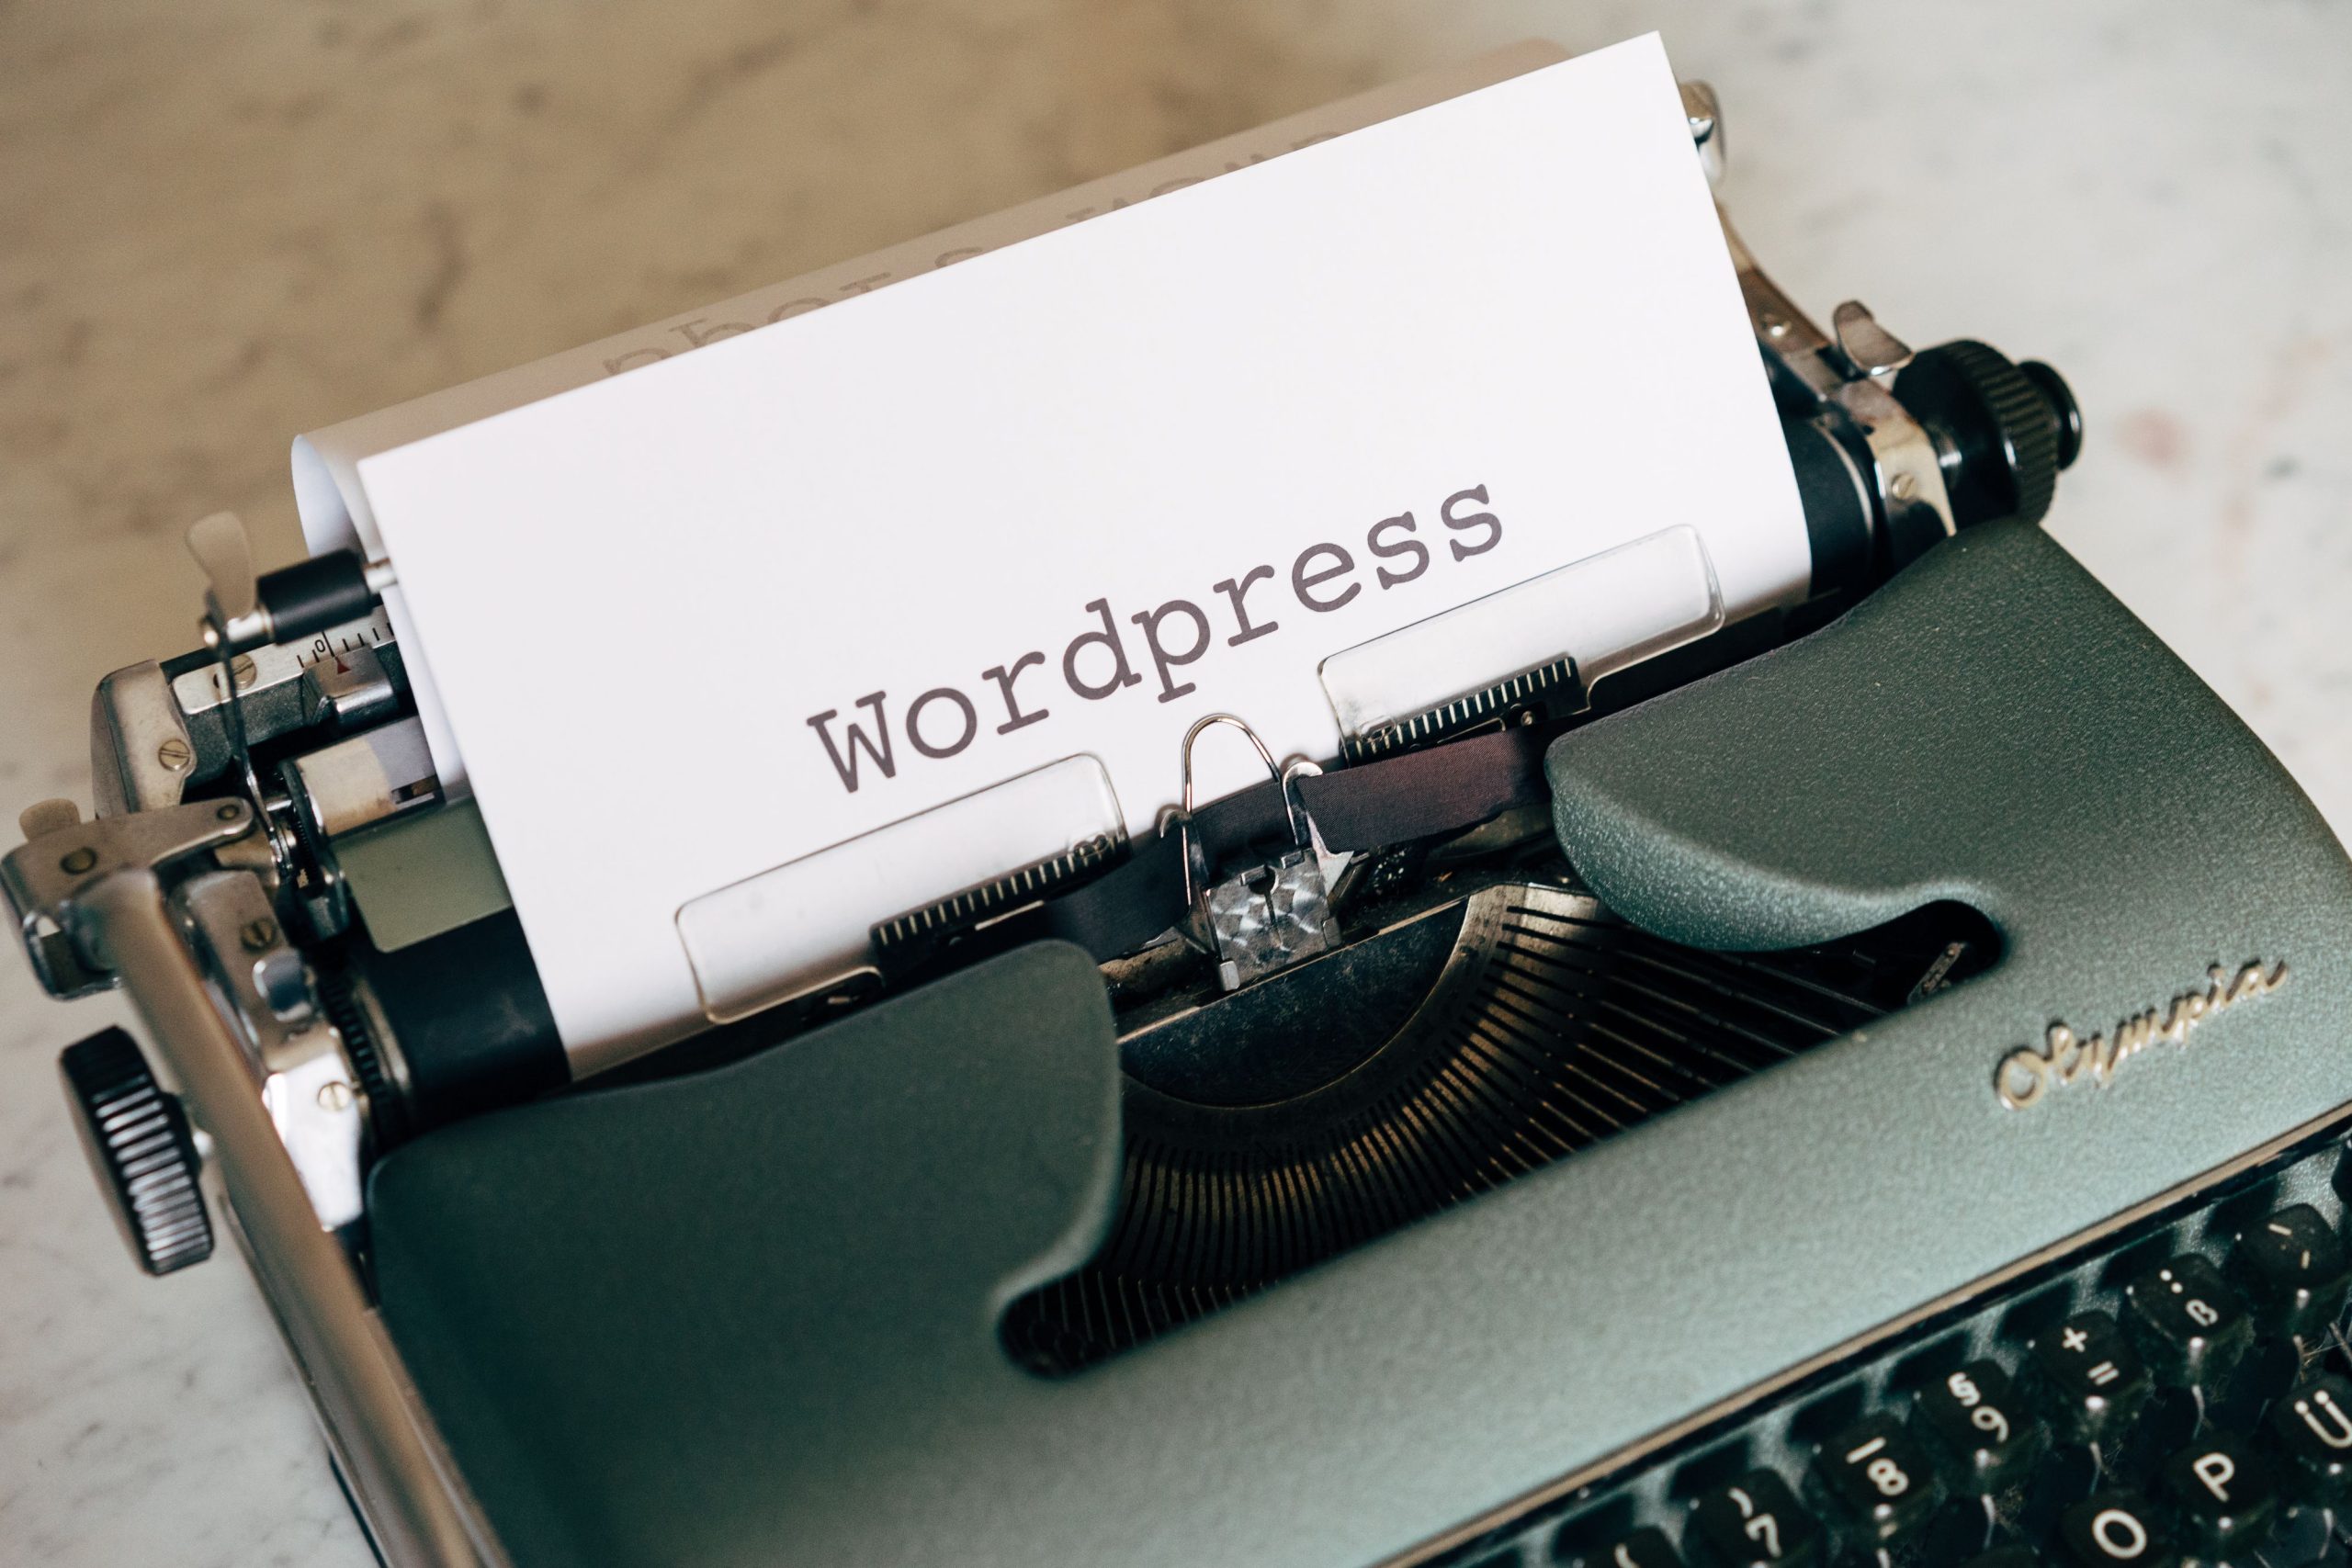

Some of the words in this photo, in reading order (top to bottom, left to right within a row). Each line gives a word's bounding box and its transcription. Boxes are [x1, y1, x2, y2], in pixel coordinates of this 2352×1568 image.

[806, 483, 1503, 794] Wordpress
[1994, 959, 2289, 1111] Olympia
[1971, 1405, 2009, 1443] 9
[1867, 1457, 1909, 1496] 8
[2193, 1452, 2234, 1503] P
[1744, 1513, 1782, 1559] 7
